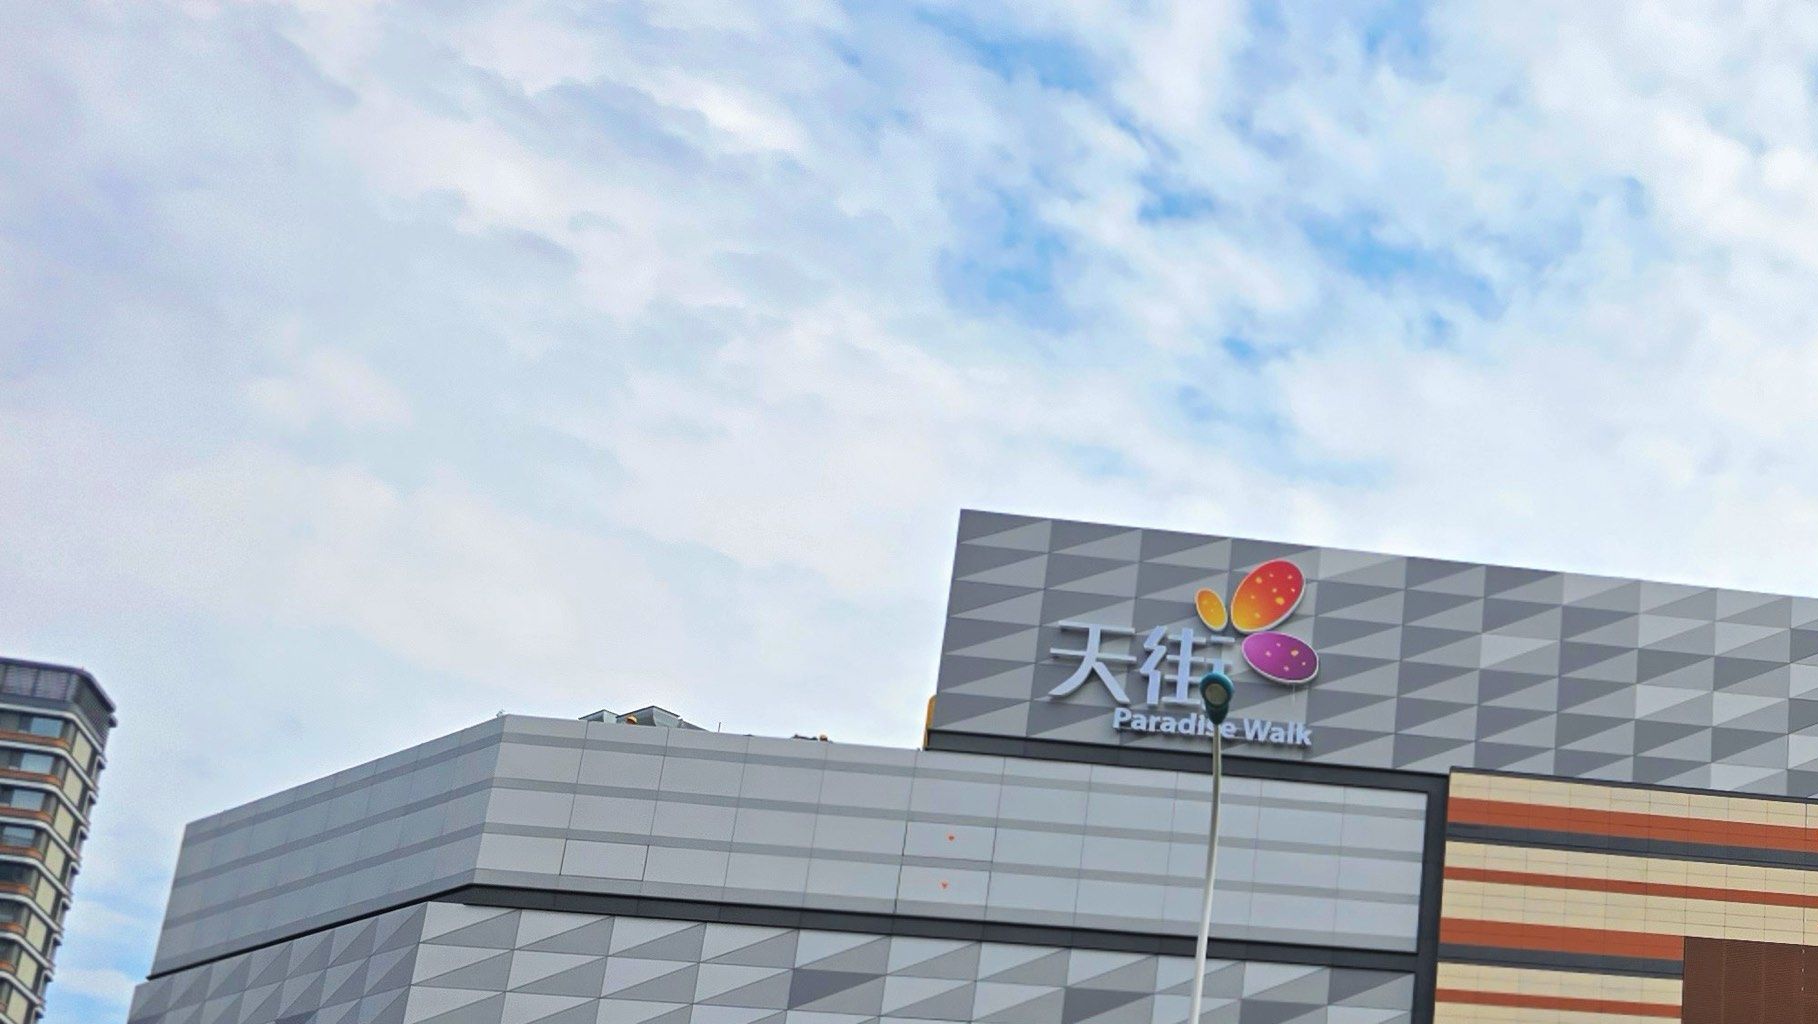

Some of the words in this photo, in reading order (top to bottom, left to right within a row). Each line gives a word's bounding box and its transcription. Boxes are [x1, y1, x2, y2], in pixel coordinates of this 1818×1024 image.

[1048, 620, 1235, 709] 天街
[1112, 707, 1237, 738] Paradise
[1243, 717, 1312, 747] Walk
